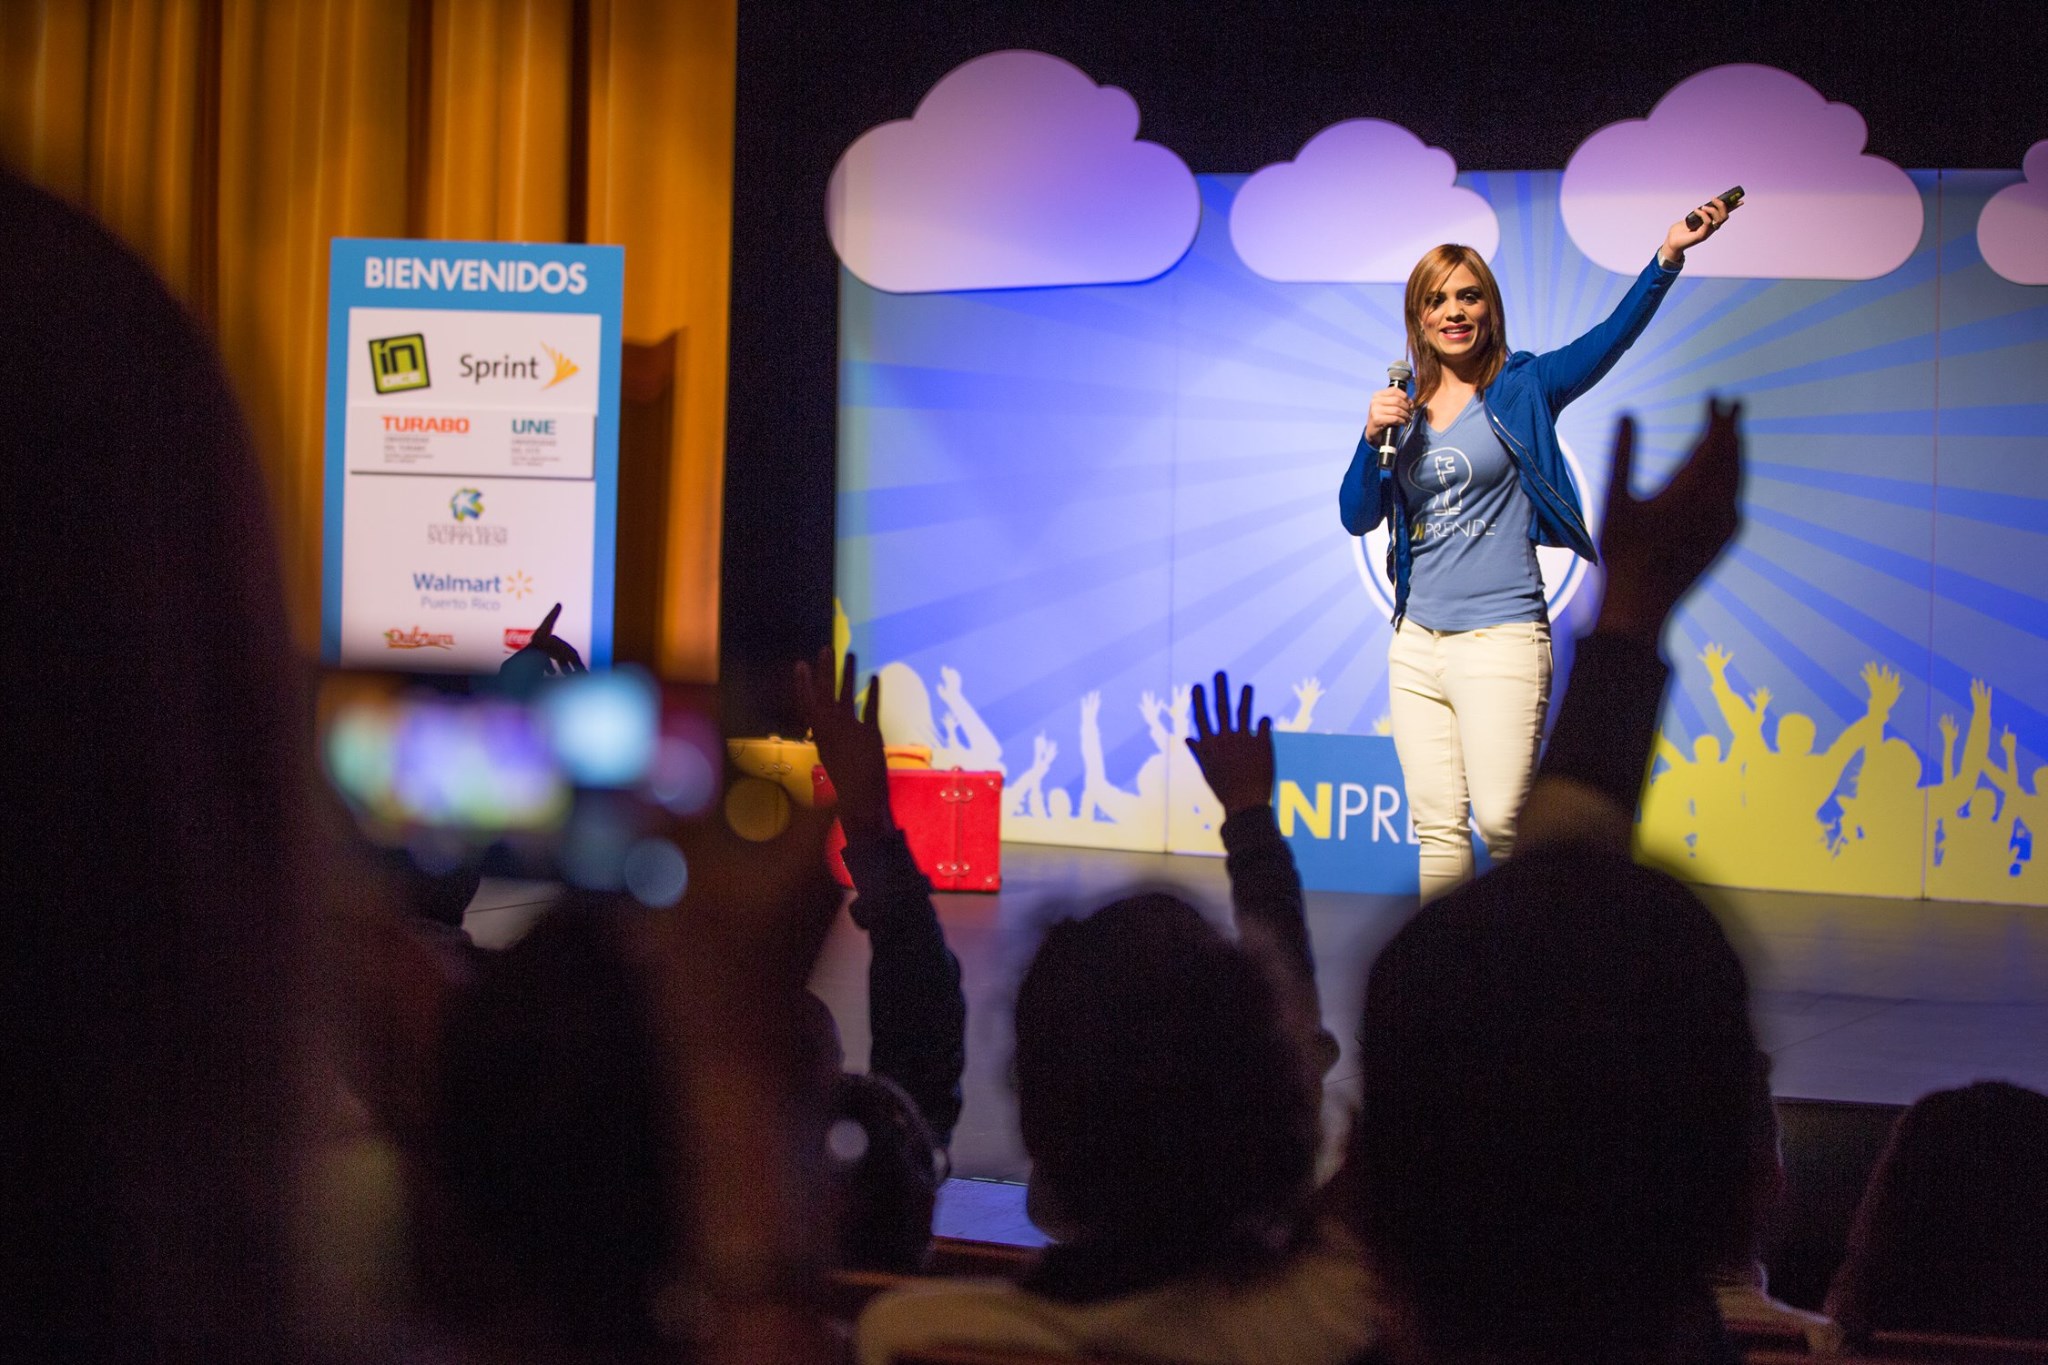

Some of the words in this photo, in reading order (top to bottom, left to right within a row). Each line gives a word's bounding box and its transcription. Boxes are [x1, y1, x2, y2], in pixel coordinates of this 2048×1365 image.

[364, 256, 589, 295] BIENVENIDOS
[458, 353, 540, 384] Sprint
[381, 415, 470, 434] TURABO
[511, 419, 557, 436] UNE
[412, 572, 501, 593] Walmart
[420, 596, 468, 610] Puerto
[471, 597, 501, 611] Rico
